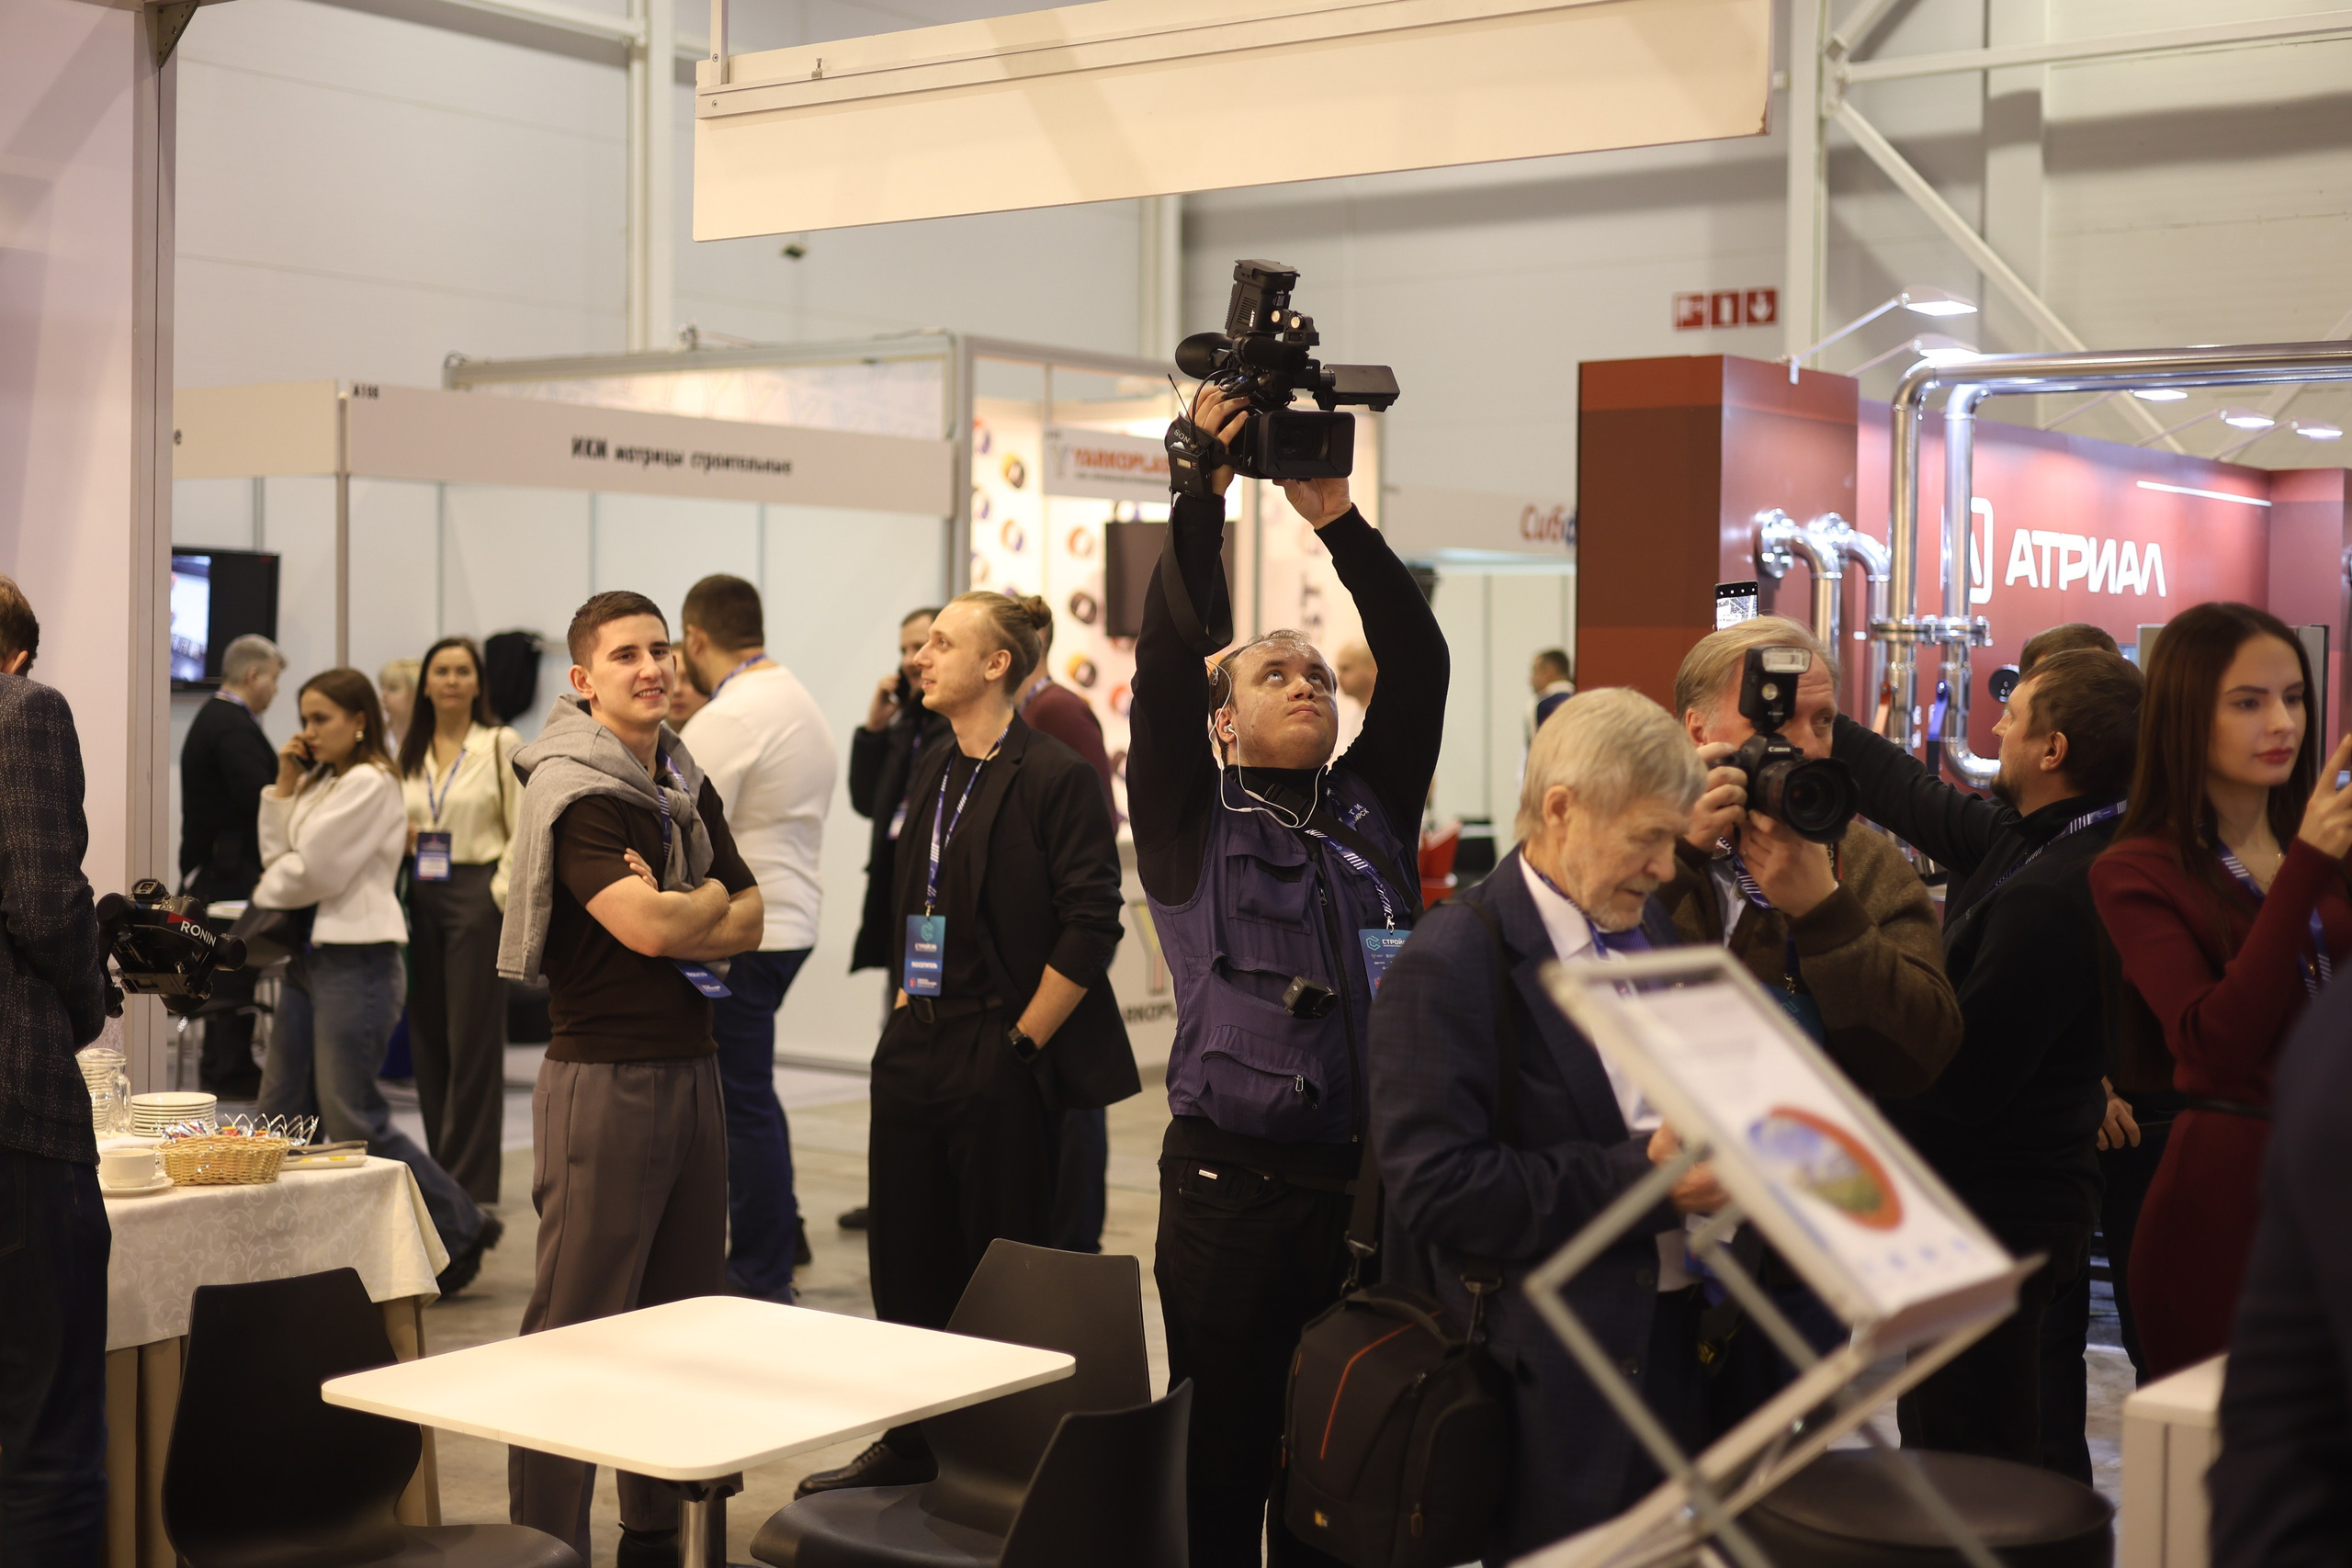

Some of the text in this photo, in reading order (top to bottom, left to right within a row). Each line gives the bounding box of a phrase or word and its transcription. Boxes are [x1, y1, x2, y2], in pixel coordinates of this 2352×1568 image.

[1173, 429, 1192, 445] SON
[615, 445, 684, 470] матрицы
[690, 450, 793, 475] строительные
[1073, 447, 1170, 474] YARKOPLA
[2004, 528, 2167, 597] АТРИАЛ
[180, 919, 217, 947] RONIN
